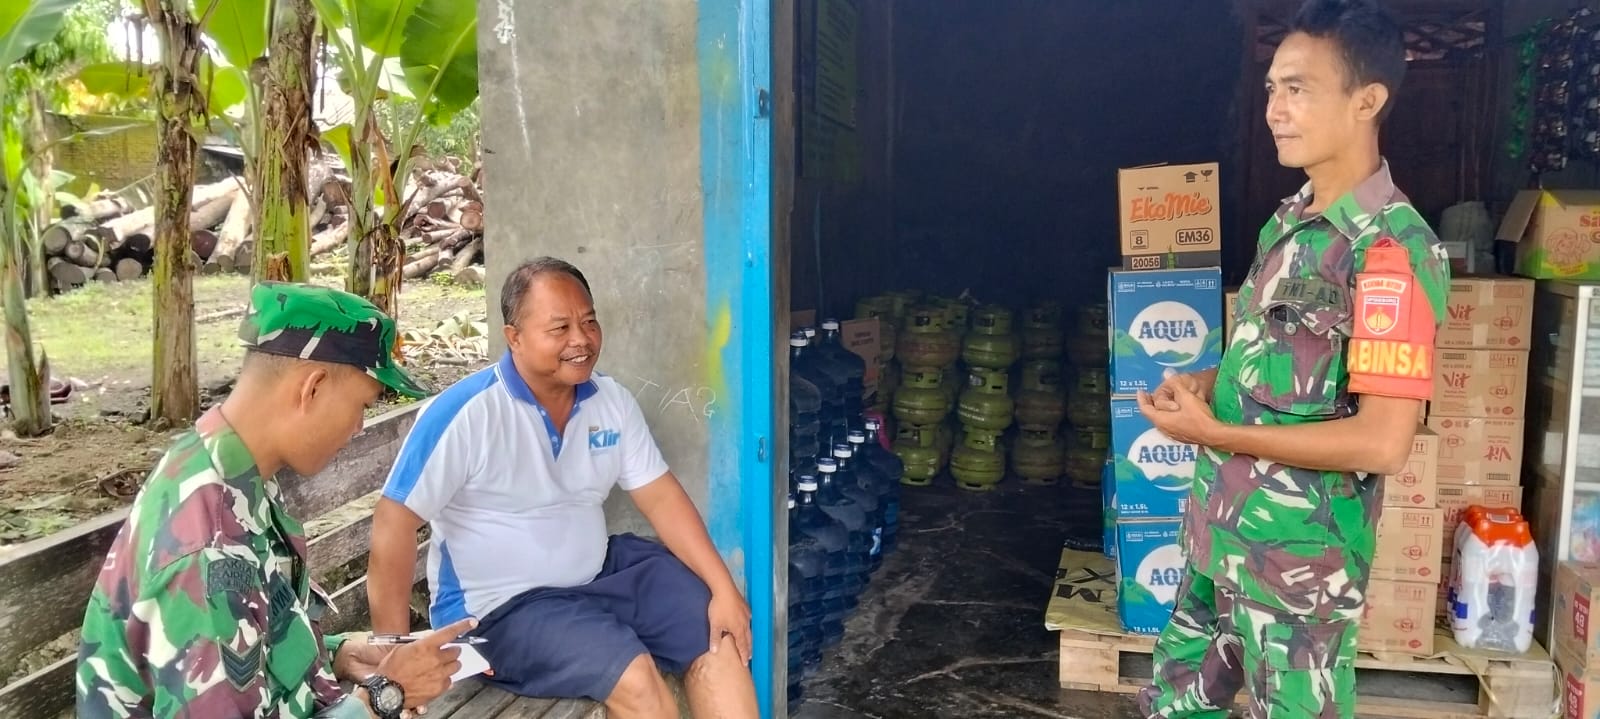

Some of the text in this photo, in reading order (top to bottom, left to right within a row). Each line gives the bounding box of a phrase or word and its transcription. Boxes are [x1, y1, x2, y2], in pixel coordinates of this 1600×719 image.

[1129, 192, 1212, 223] EkoMie
[1135, 236, 1144, 246] 8
[1178, 230, 1211, 244] EM36
[1132, 257, 1161, 269] 20056
[1447, 304, 1476, 321] Vit
[1138, 320, 1198, 342] AQUA
[1442, 371, 1471, 389] Vit
[1137, 444, 1197, 466] AQUA
[1149, 567, 1186, 586] AQ
